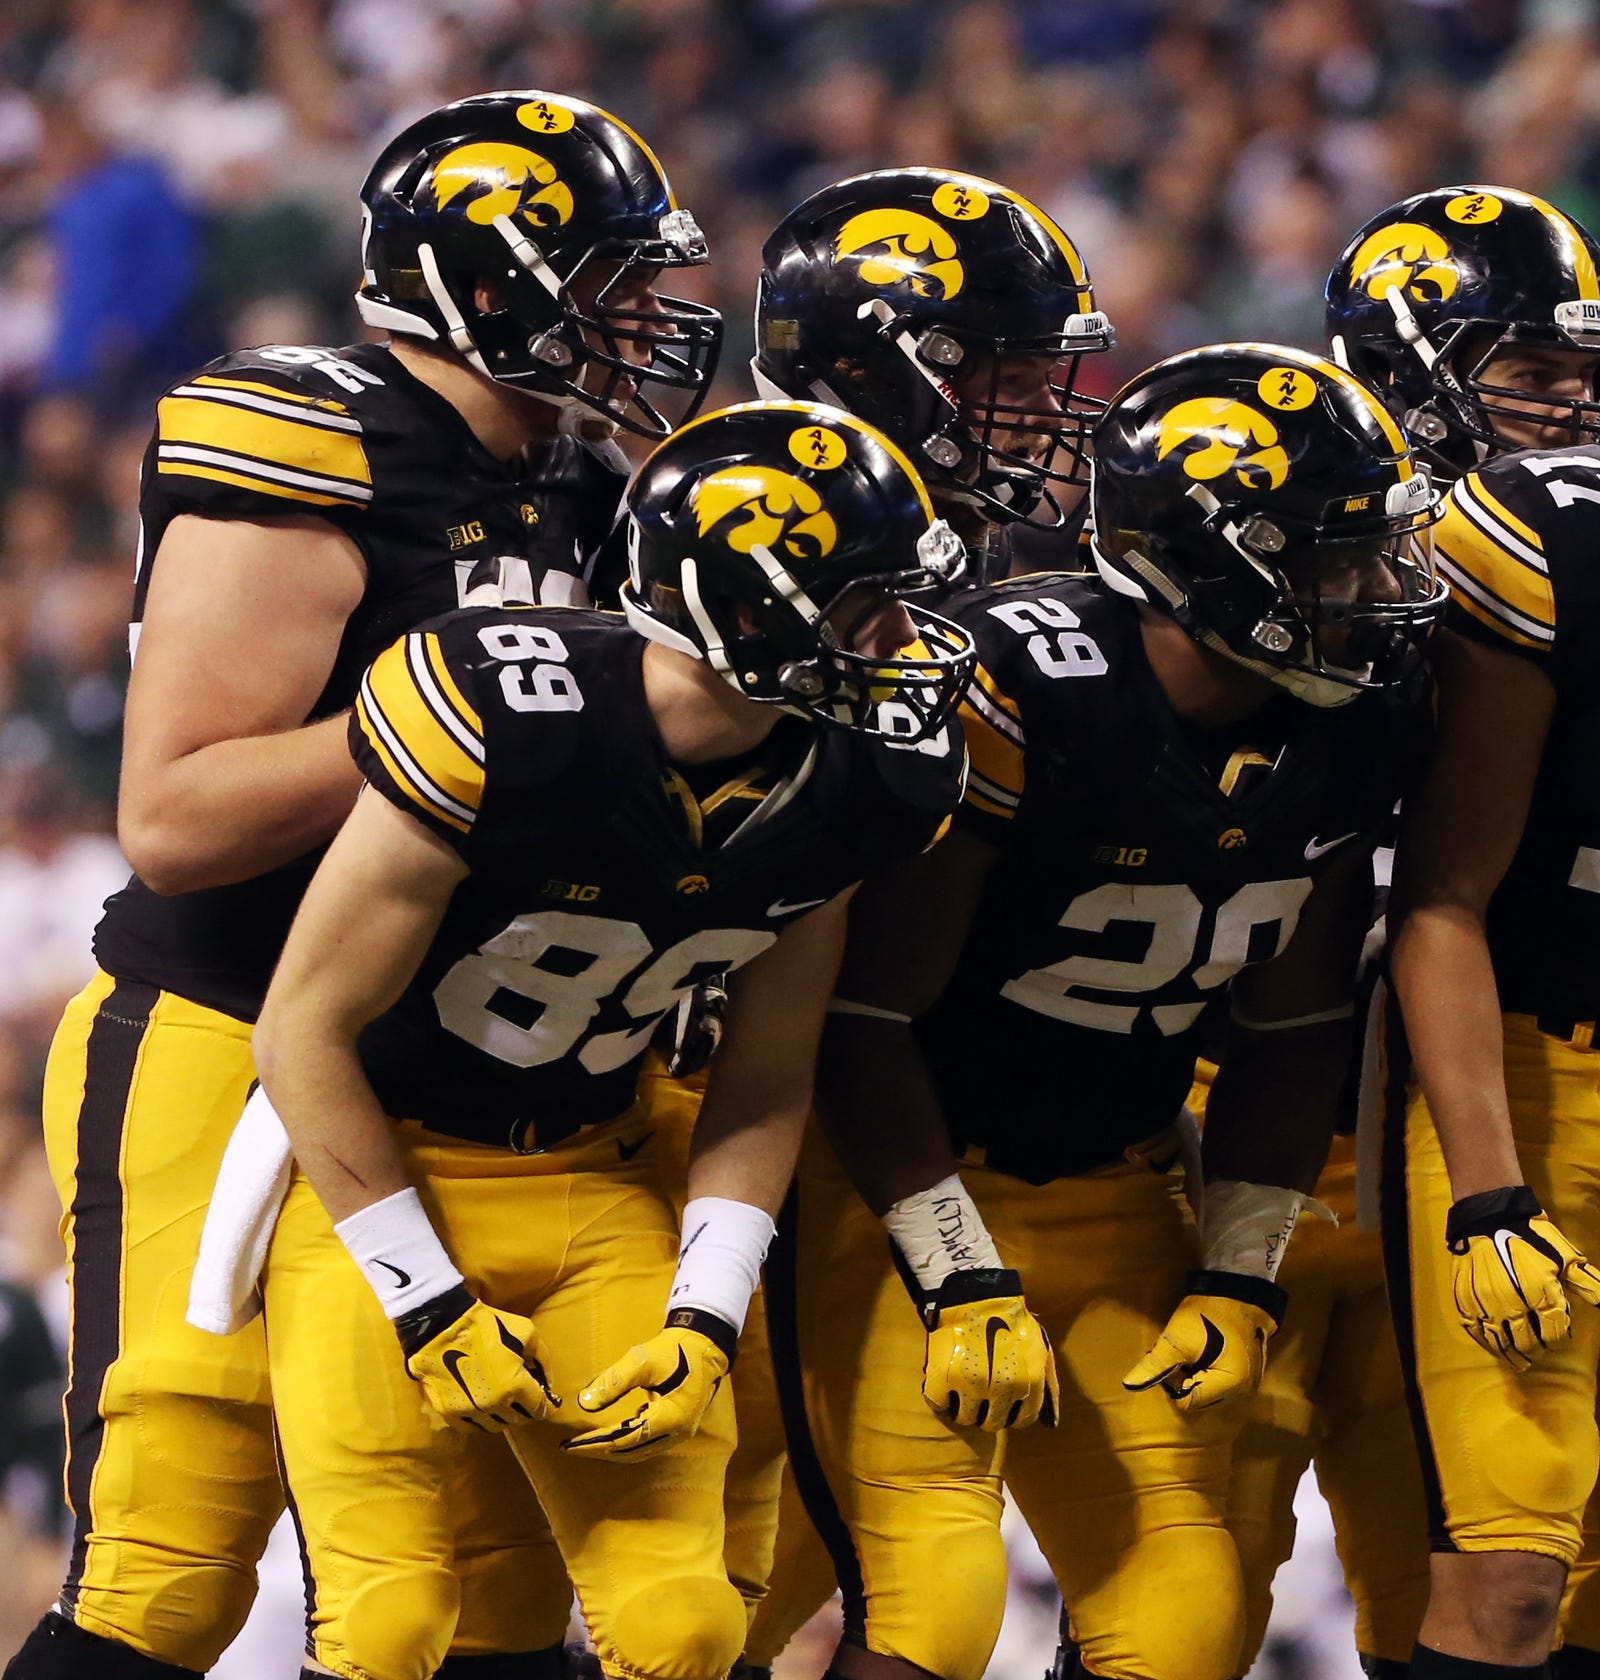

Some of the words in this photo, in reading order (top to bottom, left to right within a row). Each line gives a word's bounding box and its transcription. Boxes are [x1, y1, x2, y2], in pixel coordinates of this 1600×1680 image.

[534, 103, 557, 131] ANF
[953, 186, 971, 217] ANF
[1461, 196, 1485, 221] ANF
[1278, 371, 1297, 406] ANF
[808, 429, 829, 466] ANF
[1344, 496, 1371, 513] NIKE
[986, 597, 1109, 681] 29
[476, 623, 585, 713] 89
[999, 882, 1314, 1037] 29
[433, 908, 778, 1075] 89
[931, 1197, 985, 1270] AMILY
